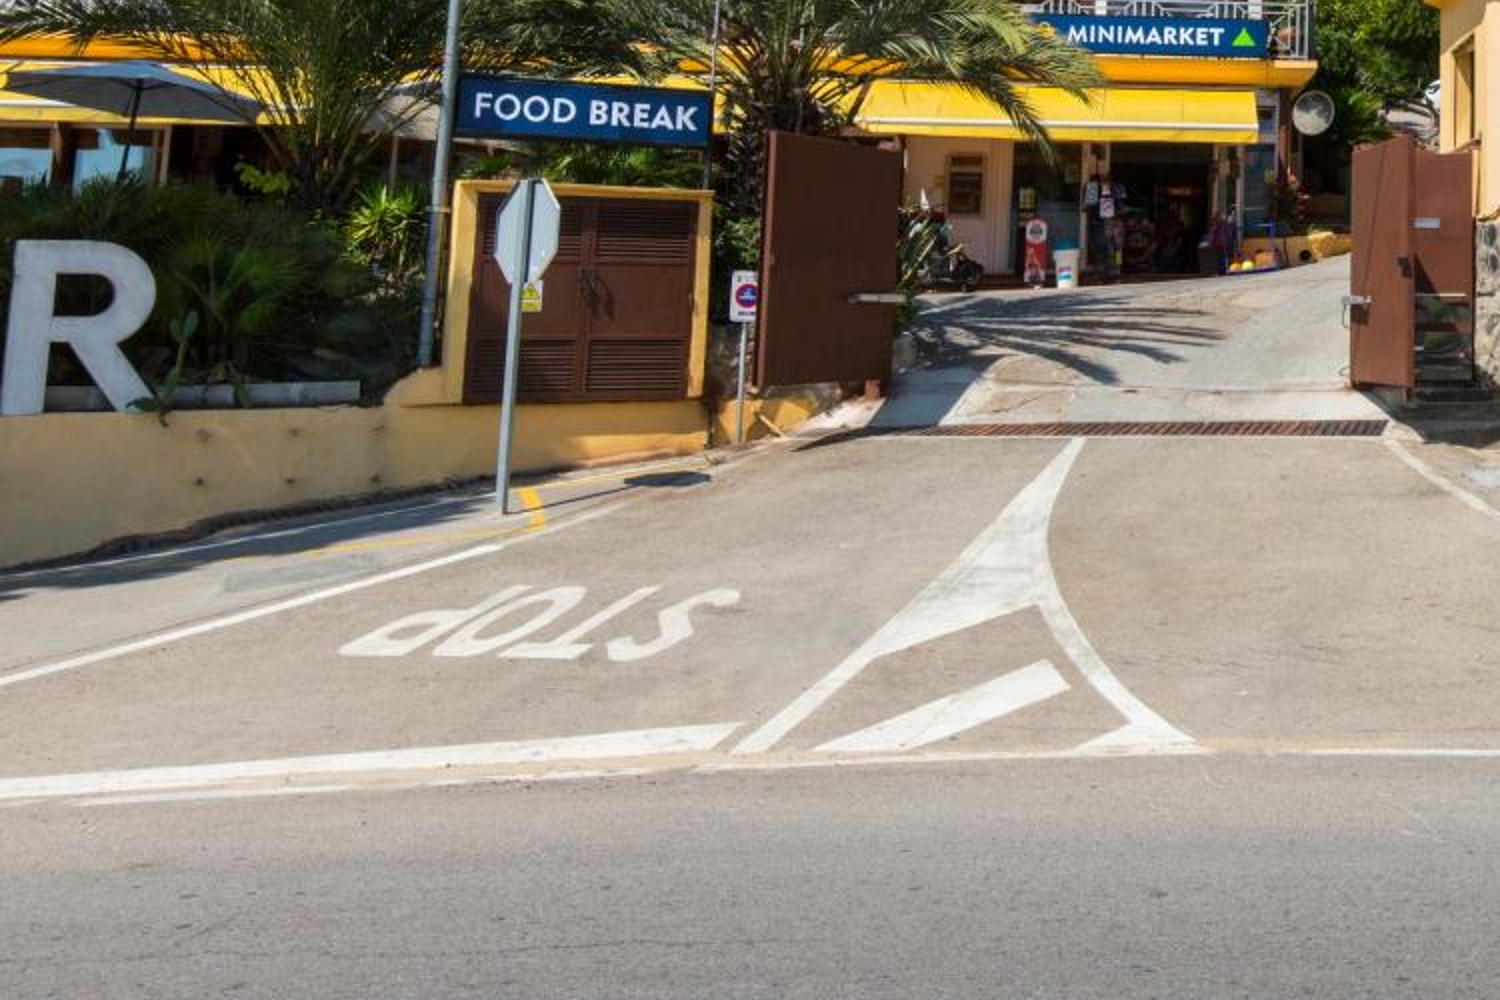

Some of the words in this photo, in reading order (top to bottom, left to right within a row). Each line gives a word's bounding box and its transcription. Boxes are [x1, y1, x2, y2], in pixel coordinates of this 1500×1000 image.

[1066, 23, 1225, 47] MINIMARKET
[474, 91, 577, 124] FOOD
[589, 98, 699, 132] BREAK
[1, 239, 157, 415] R
[337, 583, 741, 662] STOP
